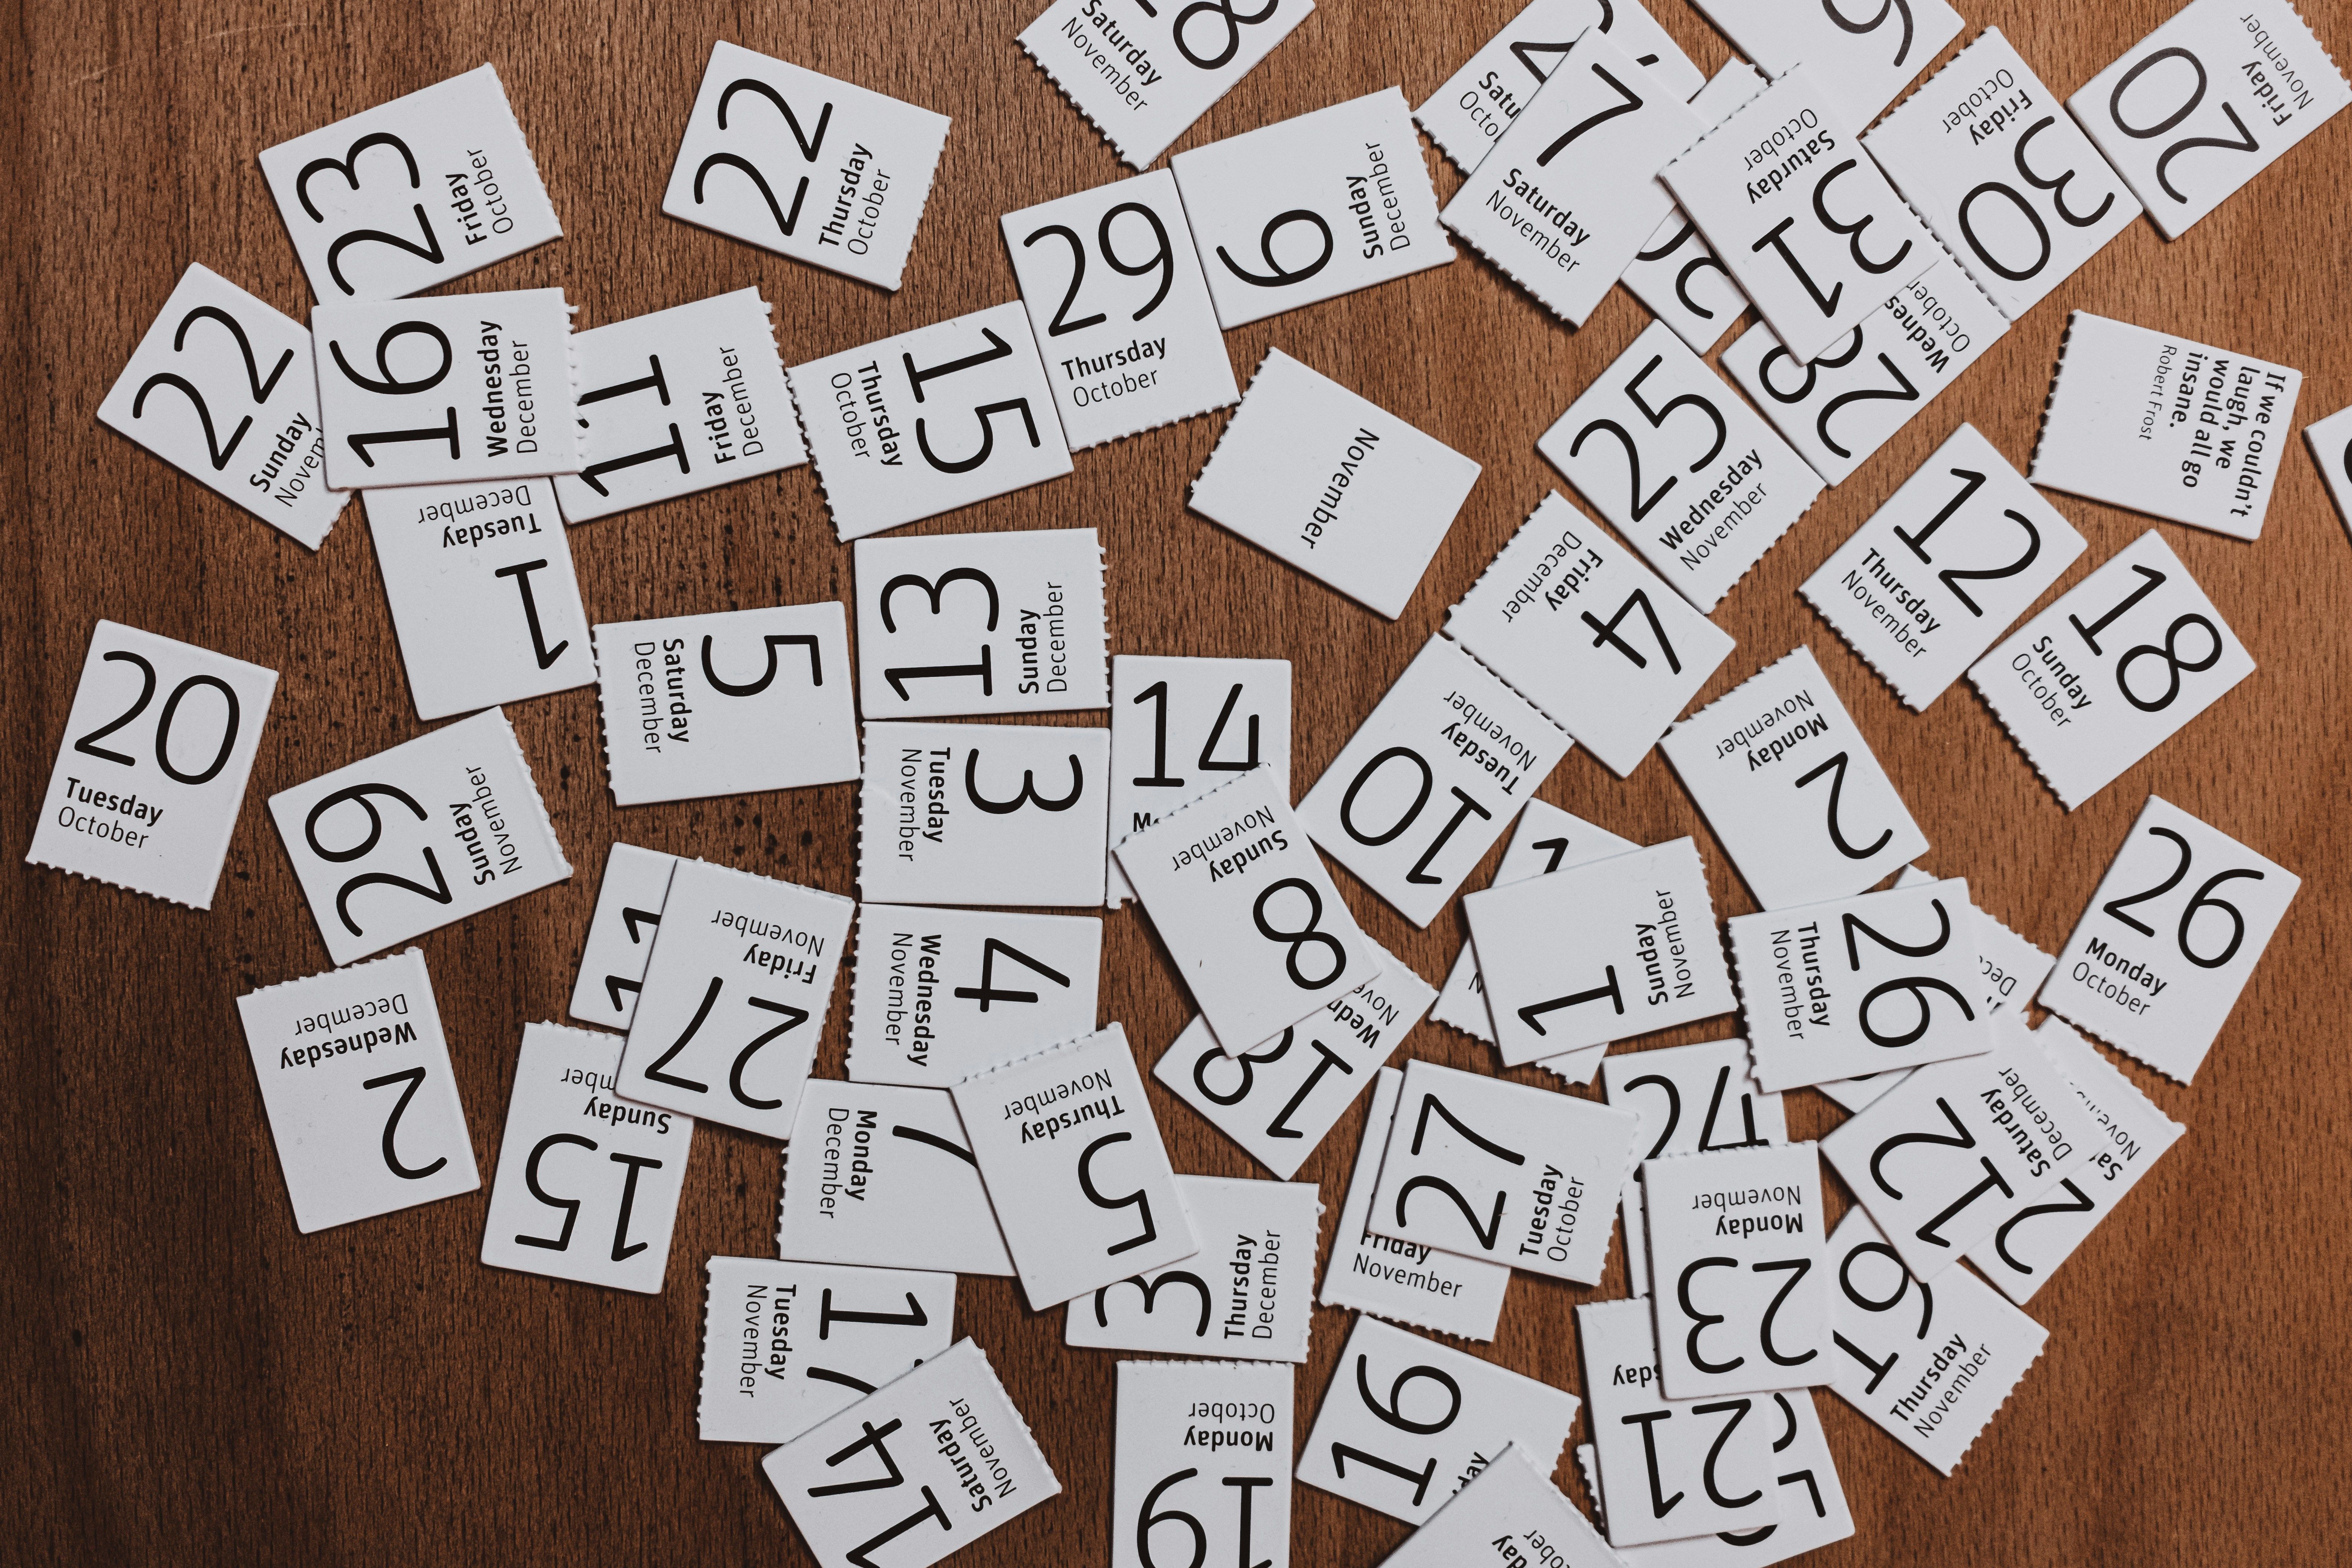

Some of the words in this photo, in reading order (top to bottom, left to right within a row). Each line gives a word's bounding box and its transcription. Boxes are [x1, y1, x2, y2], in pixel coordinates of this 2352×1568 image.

[1061, 17, 1147, 110] November
[1082, 0, 1163, 86] Saturday
[1138, 0, 1279, 70] 8
[2240, 14, 2314, 109] November
[1459, 91, 1499, 142] Octo
[1479, 72, 1521, 119] Satu
[1537, 63, 1643, 167] 7
[1943, 69, 2013, 133] October
[1970, 89, 2032, 145] Friday
[2110, 47, 2259, 204] 20
[2242, 61, 2292, 126] Friday
[694, 79, 833, 236] 22
[1744, 109, 1817, 171] October
[1747, 130, 1834, 204] Saturday
[296, 133, 444, 296] 23
[446, 174, 487, 245] Friday
[467, 150, 513, 233] October
[819, 143, 872, 246] Thursday
[848, 169, 890, 254] October
[1346, 177, 1383, 259] Sunday
[1366, 143, 1410, 251] December
[1486, 190, 1580, 272] November
[1503, 168, 1590, 246] Saturday
[1958, 116, 2115, 281] 30
[1023, 202, 1173, 337] 29
[1216, 210, 1333, 287] 6
[1752, 159, 1912, 318] 31
[1061, 338, 1165, 380] Thursday
[1885, 296, 1949, 373] Wednes
[1906, 281, 1969, 352] October
[133, 306, 294, 471] 22
[329, 321, 460, 467] 16
[477, 321, 508, 457] Wednesday
[509, 341, 537, 453] December
[720, 348, 763, 456] December
[858, 361, 902, 465] Thursday
[903, 328, 1040, 473] 15
[1074, 370, 1157, 407] October
[2151, 345, 2177, 397] Robert
[2170, 352, 2208, 427] insane.
[2200, 360, 2229, 425] would
[2222, 366, 2260, 431] laugh,
[2256, 396, 2275, 424] we
[2265, 372, 2286, 392] If
[250, 412, 312, 493] Sunday
[576, 354, 691, 497] 11
[702, 393, 736, 464] Friday
[831, 373, 870, 457] October
[1570, 355, 1726, 522] 25
[2139, 400, 2162, 440] Frost
[2190, 429, 2213, 457] all
[2216, 440, 2236, 469] we
[274, 427, 324, 507] Novem
[418, 485, 531, 523] December
[1301, 428, 1380, 549] November
[1659, 449, 1762, 550] Wednesday
[2182, 460, 2201, 487] go
[2231, 430, 2266, 517] couldn't
[444, 513, 542, 548] Tuesday
[1680, 483, 1766, 571] November
[1894, 469, 2040, 617] 12
[495, 559, 568, 669] 1
[1502, 531, 1582, 623] December
[1545, 549, 1603, 611] Friday
[1842, 570, 1926, 657] November
[1862, 548, 1940, 634] Thursday
[701, 635, 822, 697] 5
[880, 568, 999, 701] 13
[1015, 609, 1041, 694] Sunday
[1043, 582, 1067, 692] December
[1581, 588, 1681, 675] 4
[2033, 636, 2092, 709] Sunday
[2069, 565, 2222, 712] 18
[74, 651, 240, 785] 20
[635, 642, 663, 753] December
[663, 639, 692, 742] Saturday
[1444, 691, 1536, 771] November
[1717, 690, 1814, 759] November
[2013, 654, 2071, 726] October
[1133, 681, 1261, 787] 14
[1441, 723, 1519, 795] Tuesday
[1748, 713, 1828, 771] Monday
[67, 777, 163, 827] Tuesday
[466, 767, 522, 874] November
[899, 749, 922, 861] November
[922, 747, 950, 842] Tuesday
[965, 749, 1083, 814] 3
[1340, 747, 1491, 884] 10
[1795, 752, 1893, 859] 2
[59, 807, 149, 848] October
[305, 783, 452, 937] 29
[449, 804, 495, 885] Sunday
[1173, 805, 1274, 871] November
[1210, 830, 1288, 882] Sunday
[711, 910, 824, 957] November
[1253, 878, 1346, 990] 8
[2103, 827, 2264, 968] 26
[743, 944, 816, 984] Friday
[954, 938, 1070, 1012] 4
[1635, 924, 1668, 1005] Sunday
[1656, 891, 1695, 998] November
[1771, 930, 1804, 1039] November
[1798, 921, 1831, 1026] Thursday
[1842, 899, 1975, 1047] 26
[2086, 937, 2167, 996] Monday
[296, 994, 408, 1035] December
[885, 933, 913, 1045] November
[907, 935, 941, 1067] Wednesday
[1353, 983, 1400, 1026] Nove
[1518, 965, 1624, 1036] 1
[2073, 962, 2150, 1015] October
[280, 1021, 417, 1069] Wednesday
[560, 1068, 616, 1094] mber
[645, 977, 809, 1110] 27
[363, 1067, 447, 1179] 2
[583, 1096, 672, 1134] Sunday
[1005, 1069, 1112, 1120] November
[1022, 1096, 1125, 1144] Thursday
[1623, 1065, 1769, 1182] 24
[1980, 1089, 2050, 1177] Saturday
[1999, 1068, 2072, 1161] December
[515, 1133, 662, 1262] 15
[820, 1108, 849, 1218] December
[845, 1110, 877, 1201] Monday
[1078, 1132, 1156, 1256] 5
[1396, 1093, 1525, 1250] 27
[1692, 1186, 1801, 1212] November
[1870, 1097, 2014, 1248] 12
[1519, 1164, 1563, 1255] Tuesday
[1547, 1177, 1584, 1261] October
[1716, 1213, 1803, 1239] Monday
[1095, 1271, 1211, 1337] 3
[1224, 1234, 1257, 1339] Thursday
[1252, 1230, 1280, 1338] December
[1353, 1253, 1462, 1297] November
[1678, 1257, 1818, 1374] 23
[740, 1285, 768, 1398] November
[764, 1285, 796, 1380] Tuesday
[1188, 1403, 1274, 1424] October
[1890, 1334, 1966, 1421] Thursday
[1914, 1344, 1991, 1438] November
[929, 1419, 992, 1512] Saturday
[949, 1398, 1017, 1498] November
[1184, 1426, 1272, 1452] Monday
[1331, 1354, 1461, 1506] 16
[1622, 1399, 1762, 1519] 21
[807, 1418, 952, 1568] 14
